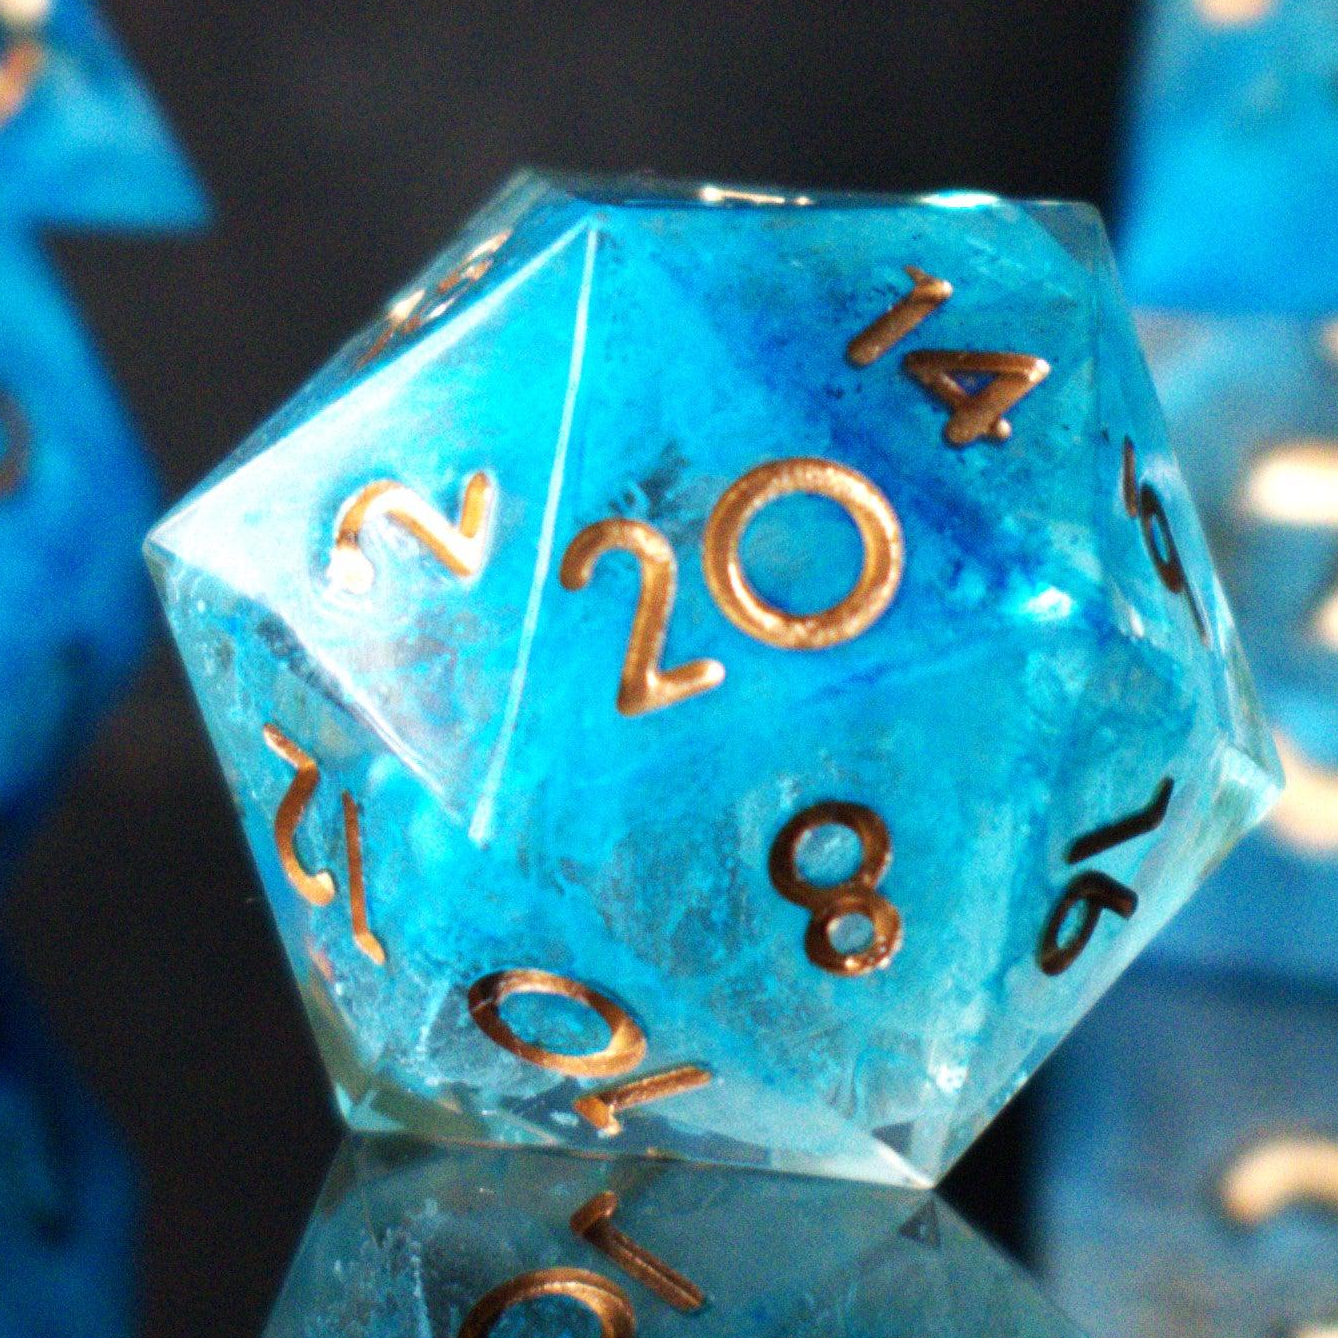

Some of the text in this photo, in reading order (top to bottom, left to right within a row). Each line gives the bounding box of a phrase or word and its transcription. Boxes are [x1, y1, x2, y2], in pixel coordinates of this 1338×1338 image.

[846, 264, 1051, 448] 14
[326, 469, 495, 596] 2
[558, 455, 904, 719] 20
[768, 799, 903, 977] 8
[466, 968, 713, 1133] 10
